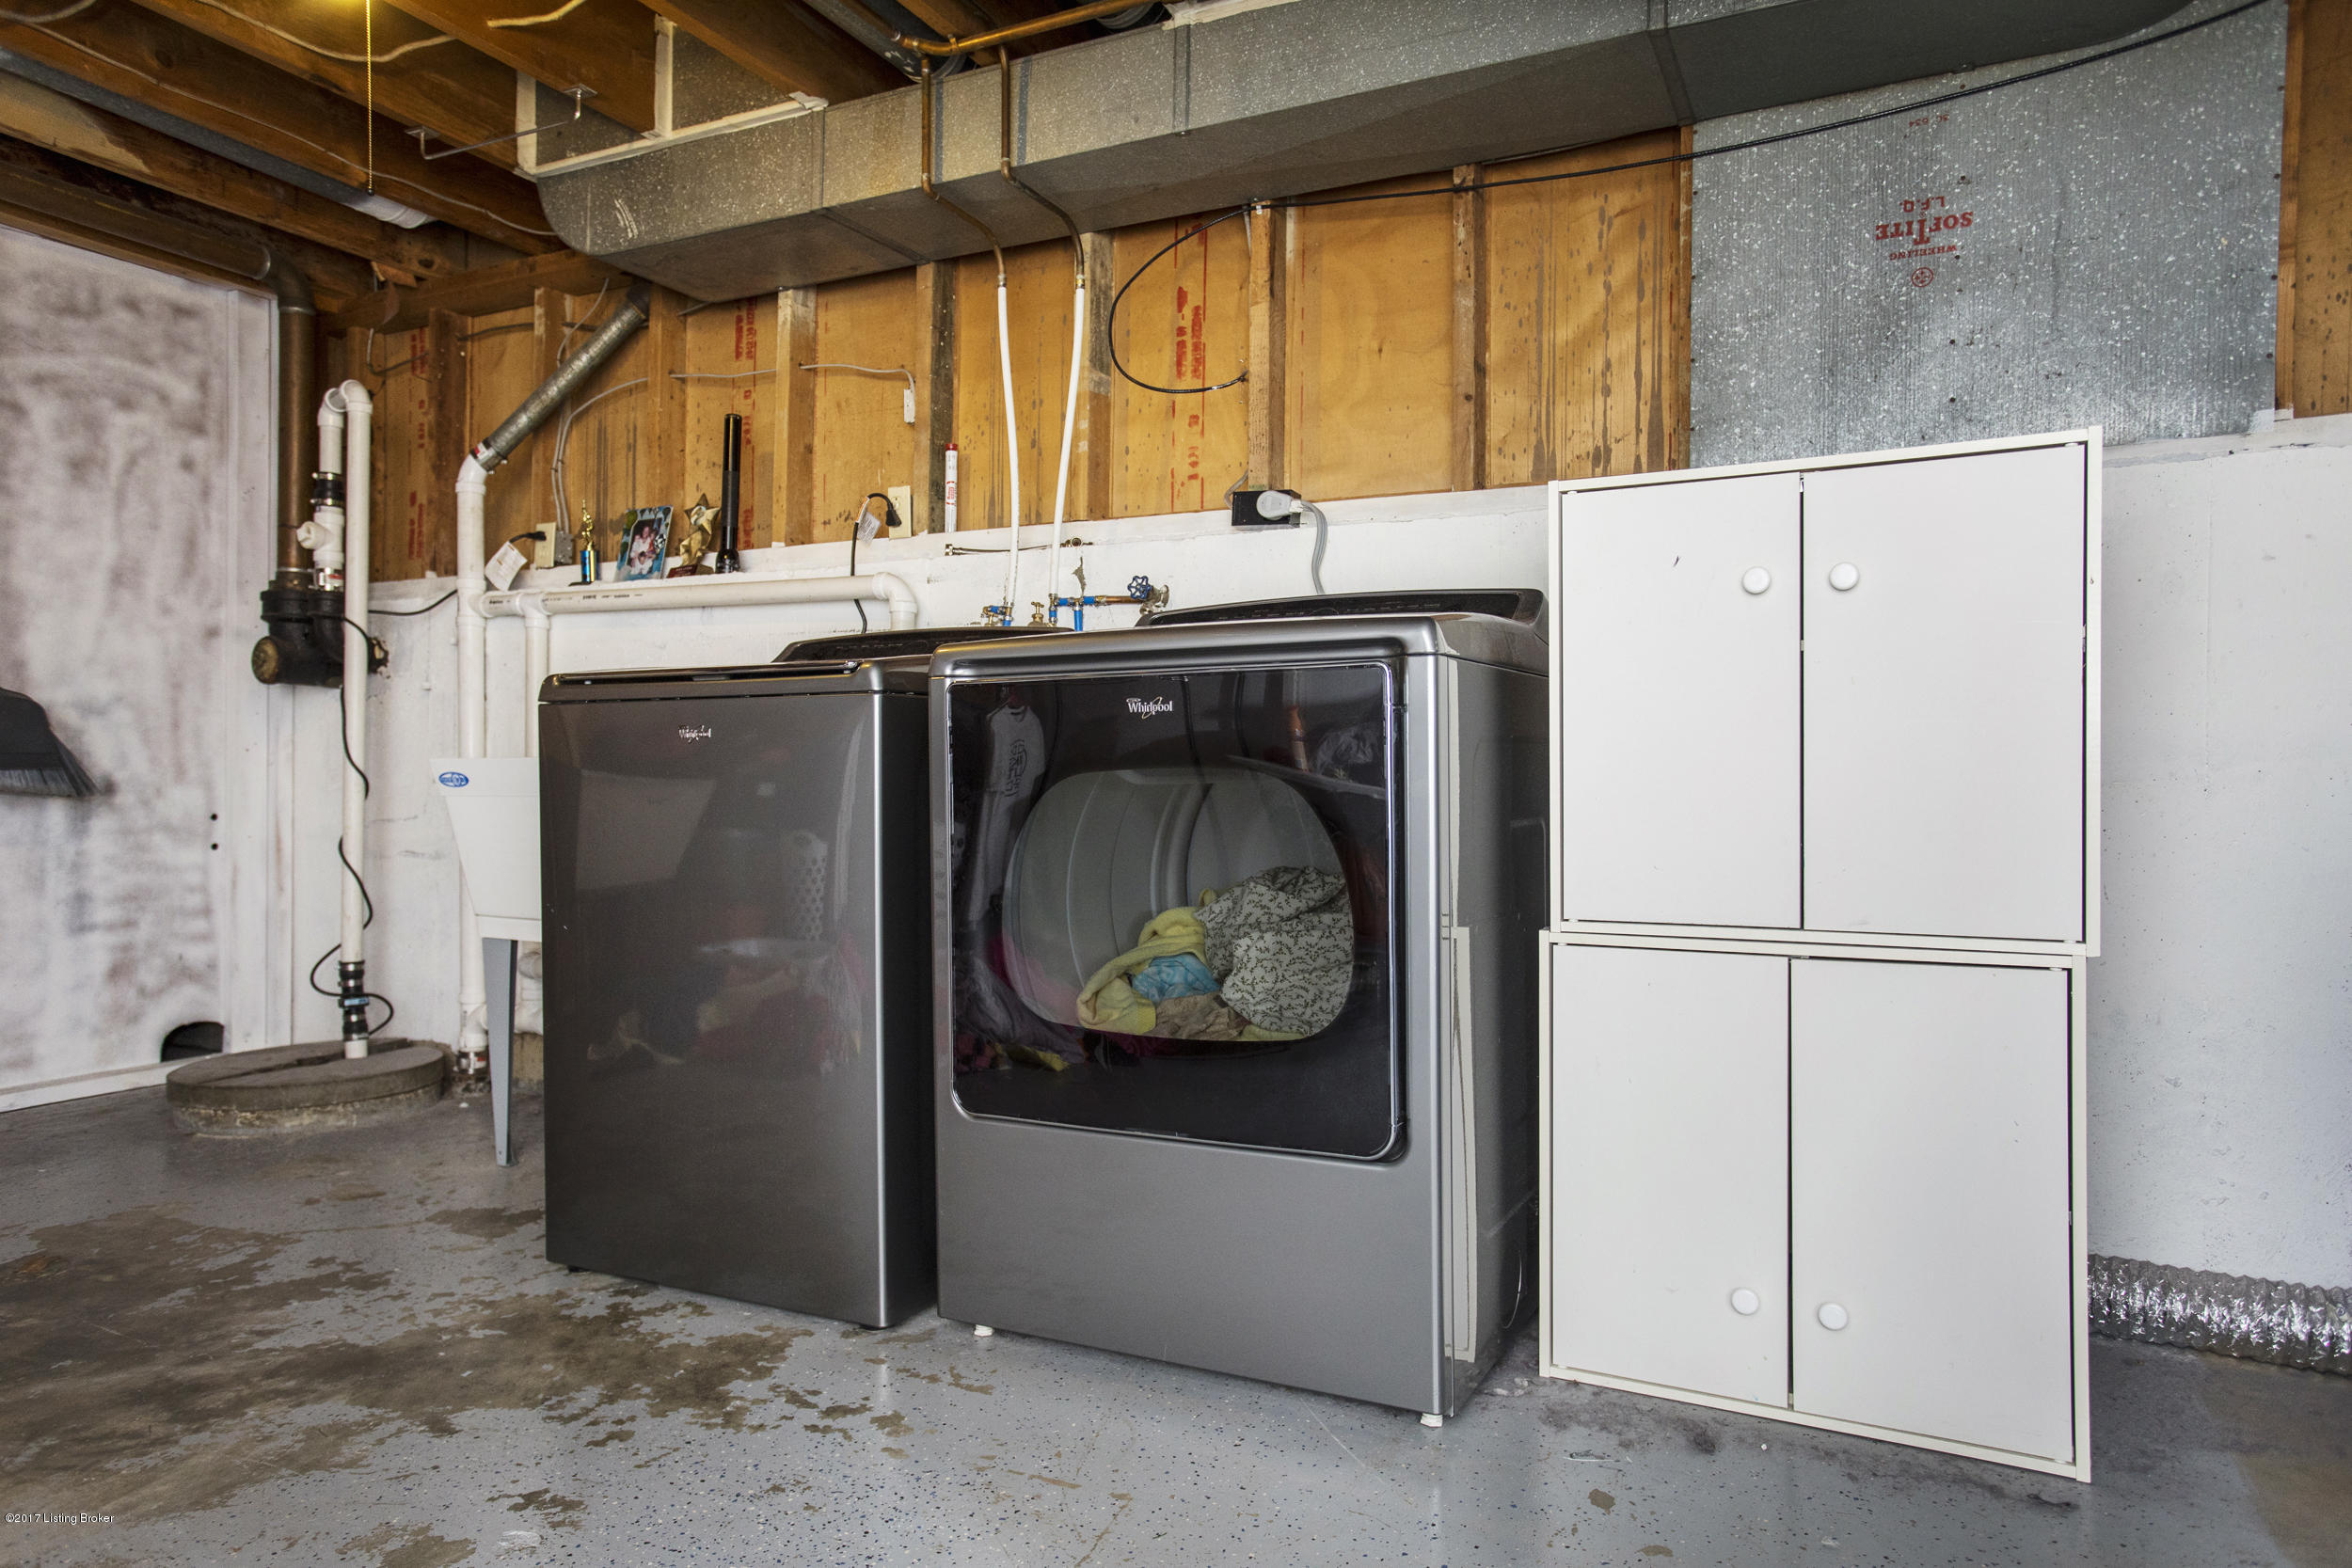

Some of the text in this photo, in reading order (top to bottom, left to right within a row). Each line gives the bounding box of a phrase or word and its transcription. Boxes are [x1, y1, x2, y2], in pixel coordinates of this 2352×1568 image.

[1899, 196, 1945, 213] L.F.Q.
[1875, 212, 1974, 245] SOFTITE
[1889, 245, 1957, 261] WHEELING
[1126, 698, 1173, 717] Whirlpool
